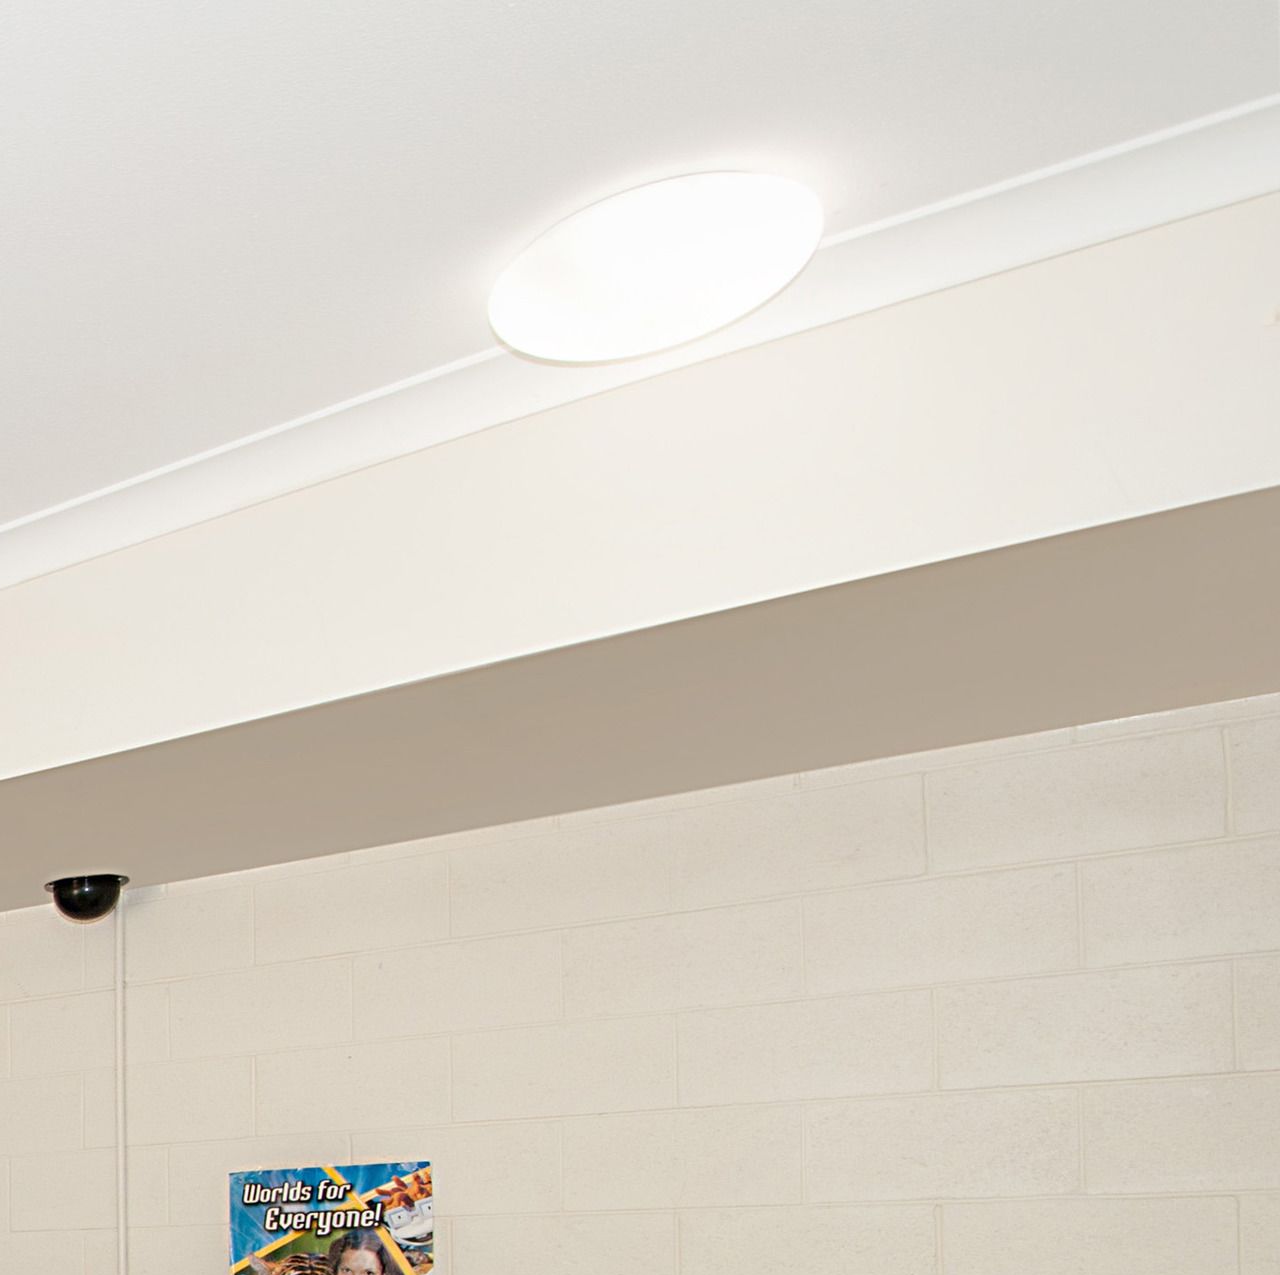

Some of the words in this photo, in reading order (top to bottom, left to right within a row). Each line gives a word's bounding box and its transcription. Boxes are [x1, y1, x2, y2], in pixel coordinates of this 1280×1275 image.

[243, 1181, 312, 1204] Worlds
[317, 1180, 351, 1200] for
[265, 1203, 382, 1236] Everyone!
